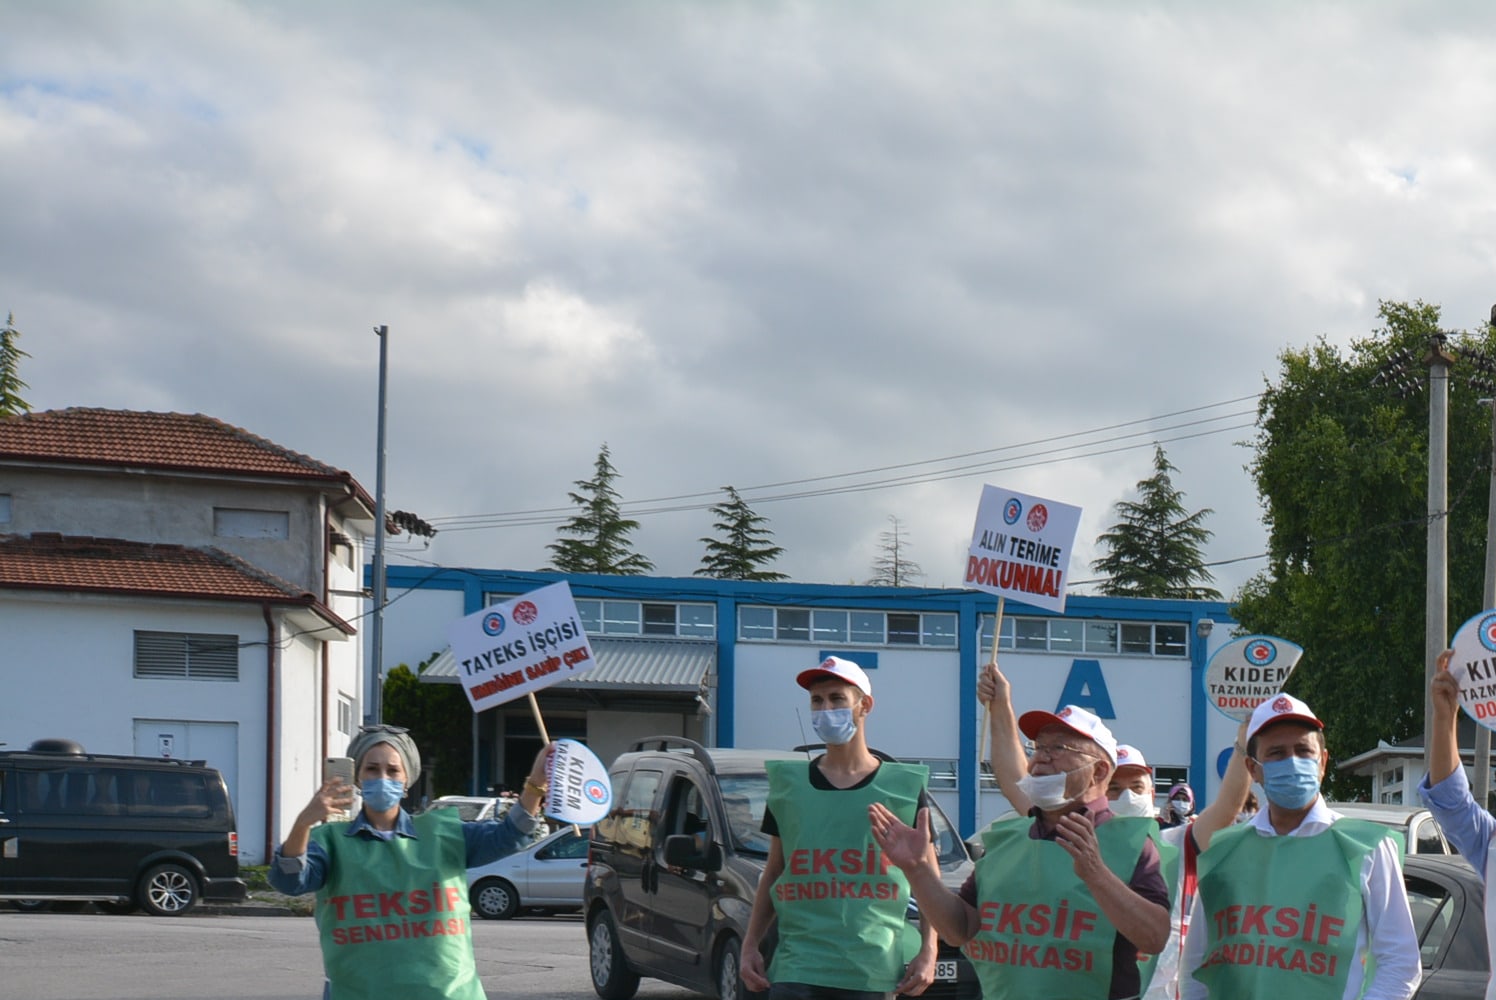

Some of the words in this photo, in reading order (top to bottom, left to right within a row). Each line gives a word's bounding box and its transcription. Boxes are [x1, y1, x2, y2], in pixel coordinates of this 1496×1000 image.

[979, 530, 1007, 553] ALIN
[1010, 536, 1061, 568] TERİME
[966, 555, 1062, 598] DOKUNMA!
[462, 640, 527, 676] TAYEKS
[527, 617, 580, 655] İŞÇİSİ
[1055, 659, 1116, 719] A
[1210, 684, 1280, 695] TAZMİNAT
[1224, 666, 1291, 682] KIDEM
[567, 757, 584, 810] KIDEM
[331, 882, 460, 921] TEKSİF
[776, 877, 899, 901] SENDİKASI
[332, 918, 465, 945] SENDİKASI
[979, 898, 1097, 941] EKSİF
[1214, 903, 1345, 946] TEKSİF
